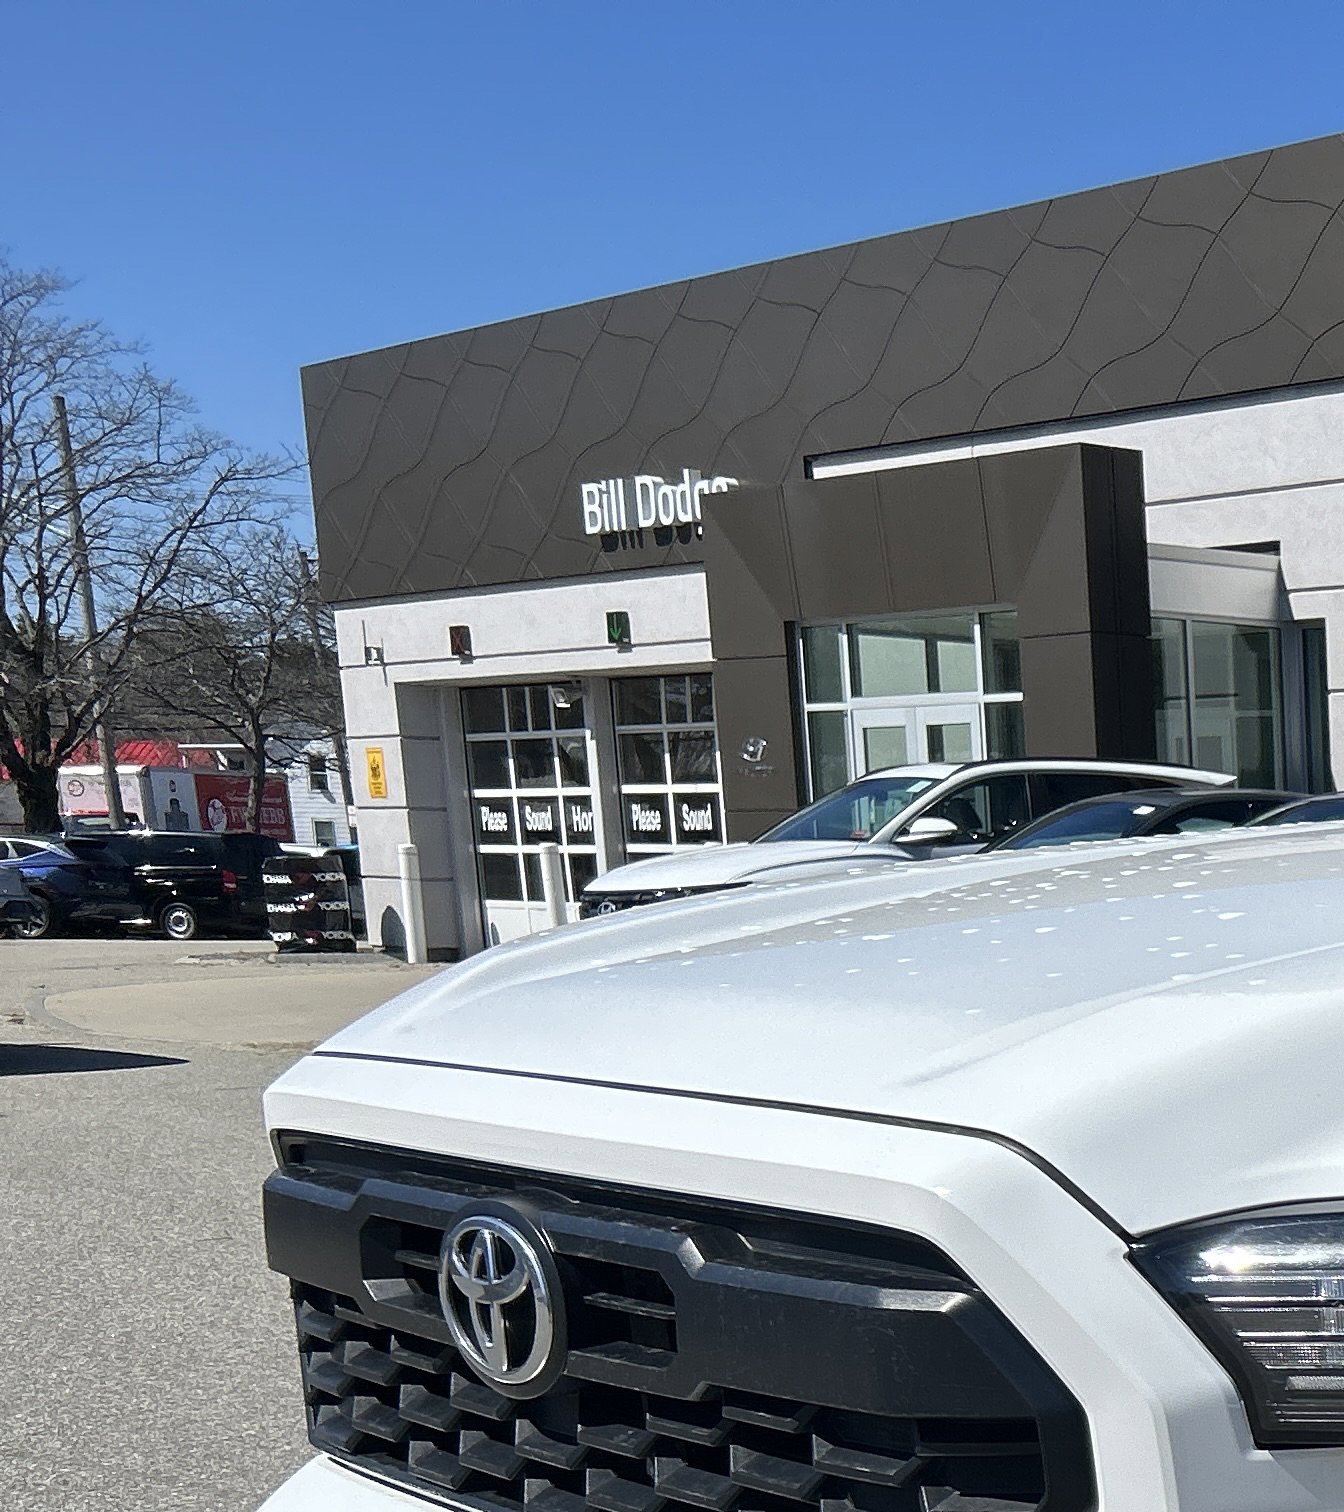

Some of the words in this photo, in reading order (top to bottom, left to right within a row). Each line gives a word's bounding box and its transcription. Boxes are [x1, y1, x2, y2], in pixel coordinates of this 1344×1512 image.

[581, 477, 628, 536] Bill
[480, 805, 508, 833] Please
[525, 804, 553, 832] Sound
[571, 804, 594, 833] Hor
[631, 803, 661, 832] Please
[681, 802, 714, 831] Sound
